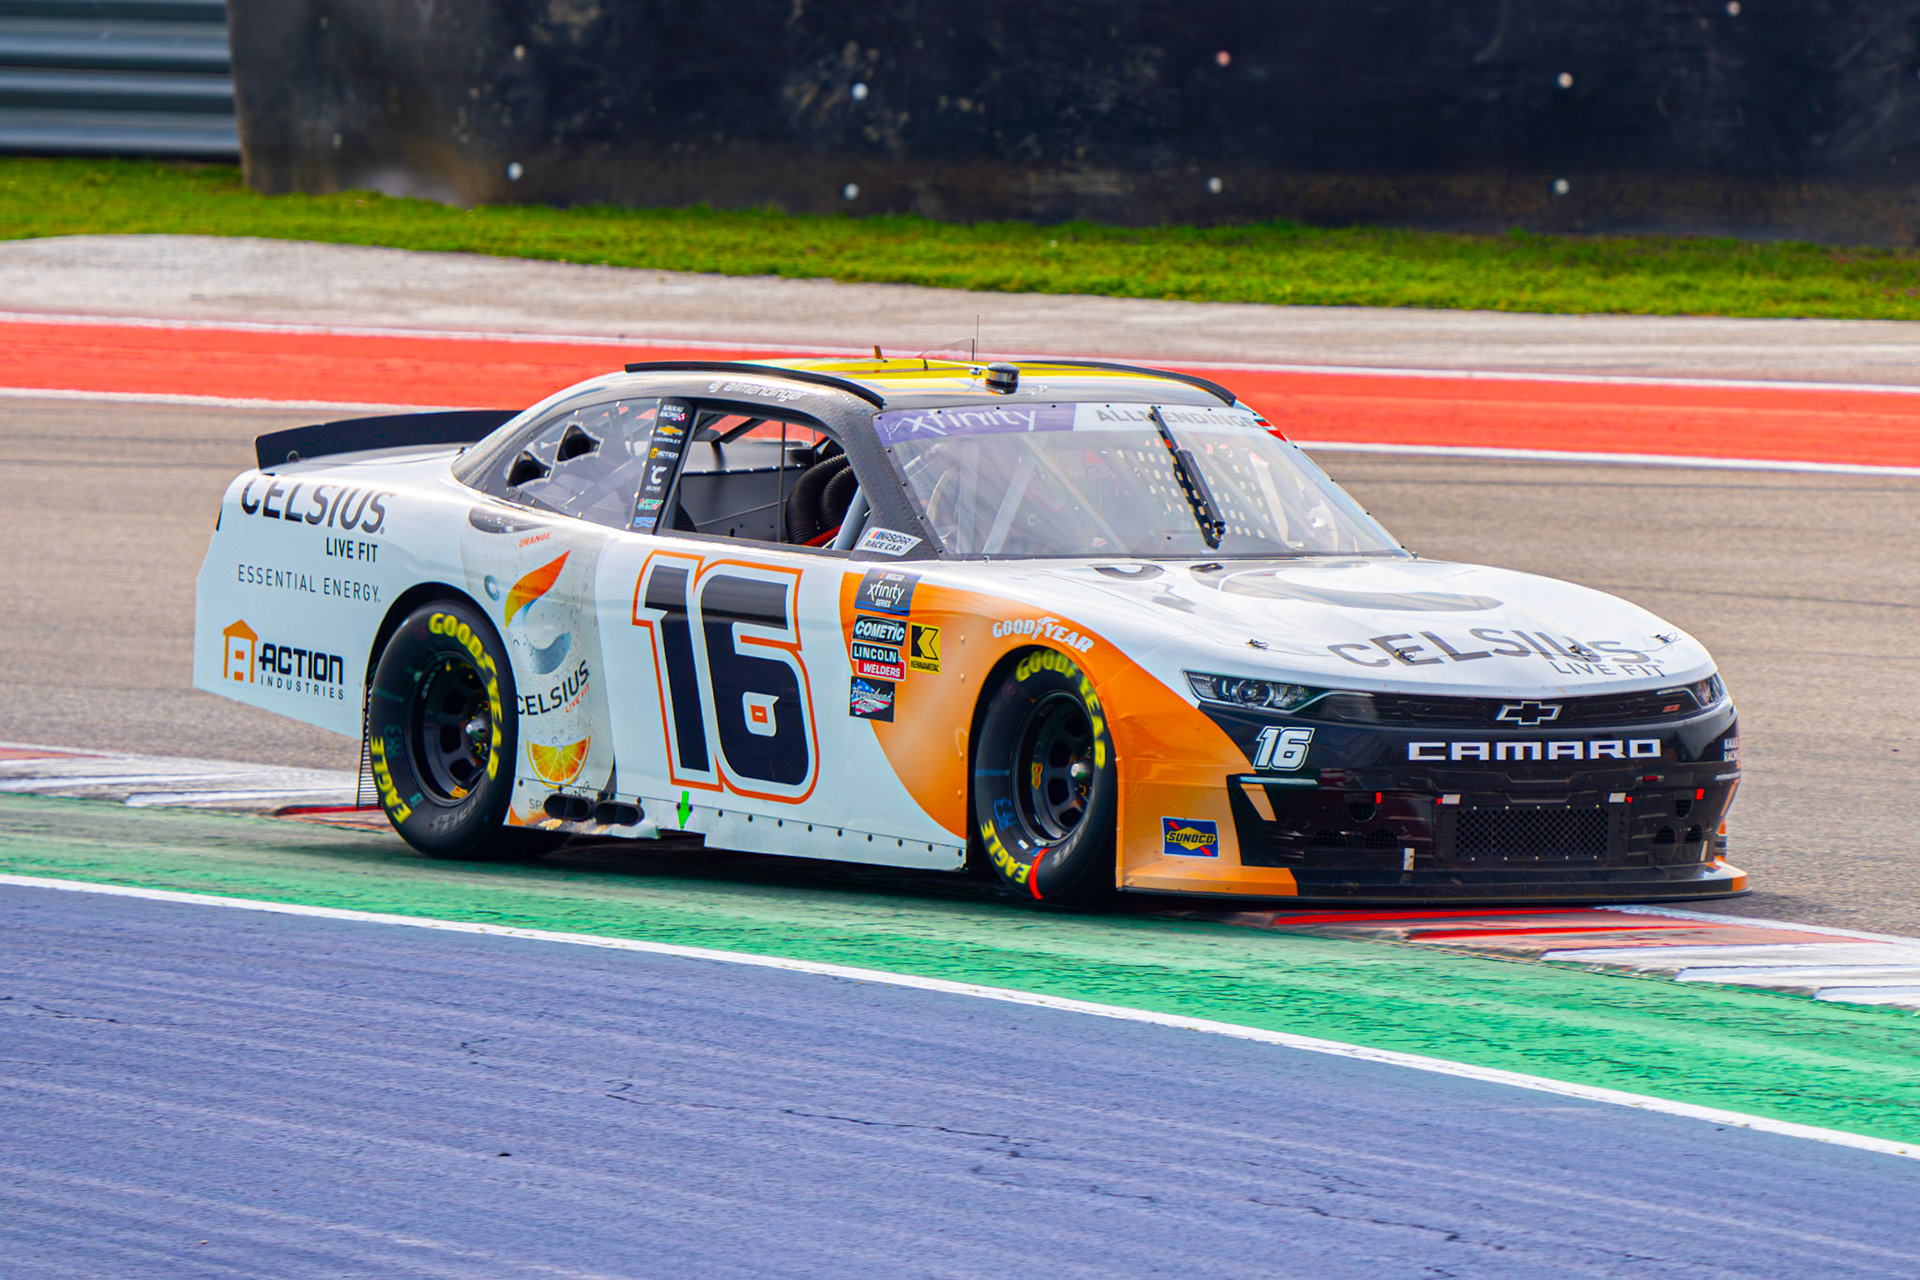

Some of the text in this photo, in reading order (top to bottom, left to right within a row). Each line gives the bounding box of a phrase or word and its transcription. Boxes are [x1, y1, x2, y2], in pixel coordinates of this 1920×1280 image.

[902, 409, 1036, 435] xfinity
[240, 478, 397, 533] CELSIUS
[326, 537, 378, 563] LIVE FIT
[864, 540, 903, 552] RACE CAR
[879, 531, 912, 546] NASCAR
[238, 564, 316, 593] ESSENTIAL
[866, 580, 906, 606] xfinity
[853, 620, 906, 642] COMETIC
[853, 645, 898, 663] LINCOLN
[1327, 628, 1651, 668] CELSIUS
[258, 642, 344, 685] ACTION
[863, 662, 901, 678] WELDERS
[910, 660, 940, 673] KENNAMETAL
[1549, 660, 1666, 678] LIVE FIT
[260, 674, 344, 701] INDUSTRIES
[517, 660, 590, 716] CELSIUS
[634, 552, 818, 802] 16
[565, 682, 590, 713] LIVE FIT
[1253, 726, 1316, 771] 16
[1408, 739, 1662, 761] CAMARO
[370, 735, 412, 824] EAGLE
[980, 819, 1031, 884] EAGLE
[1168, 832, 1215, 845] SUNOCO
